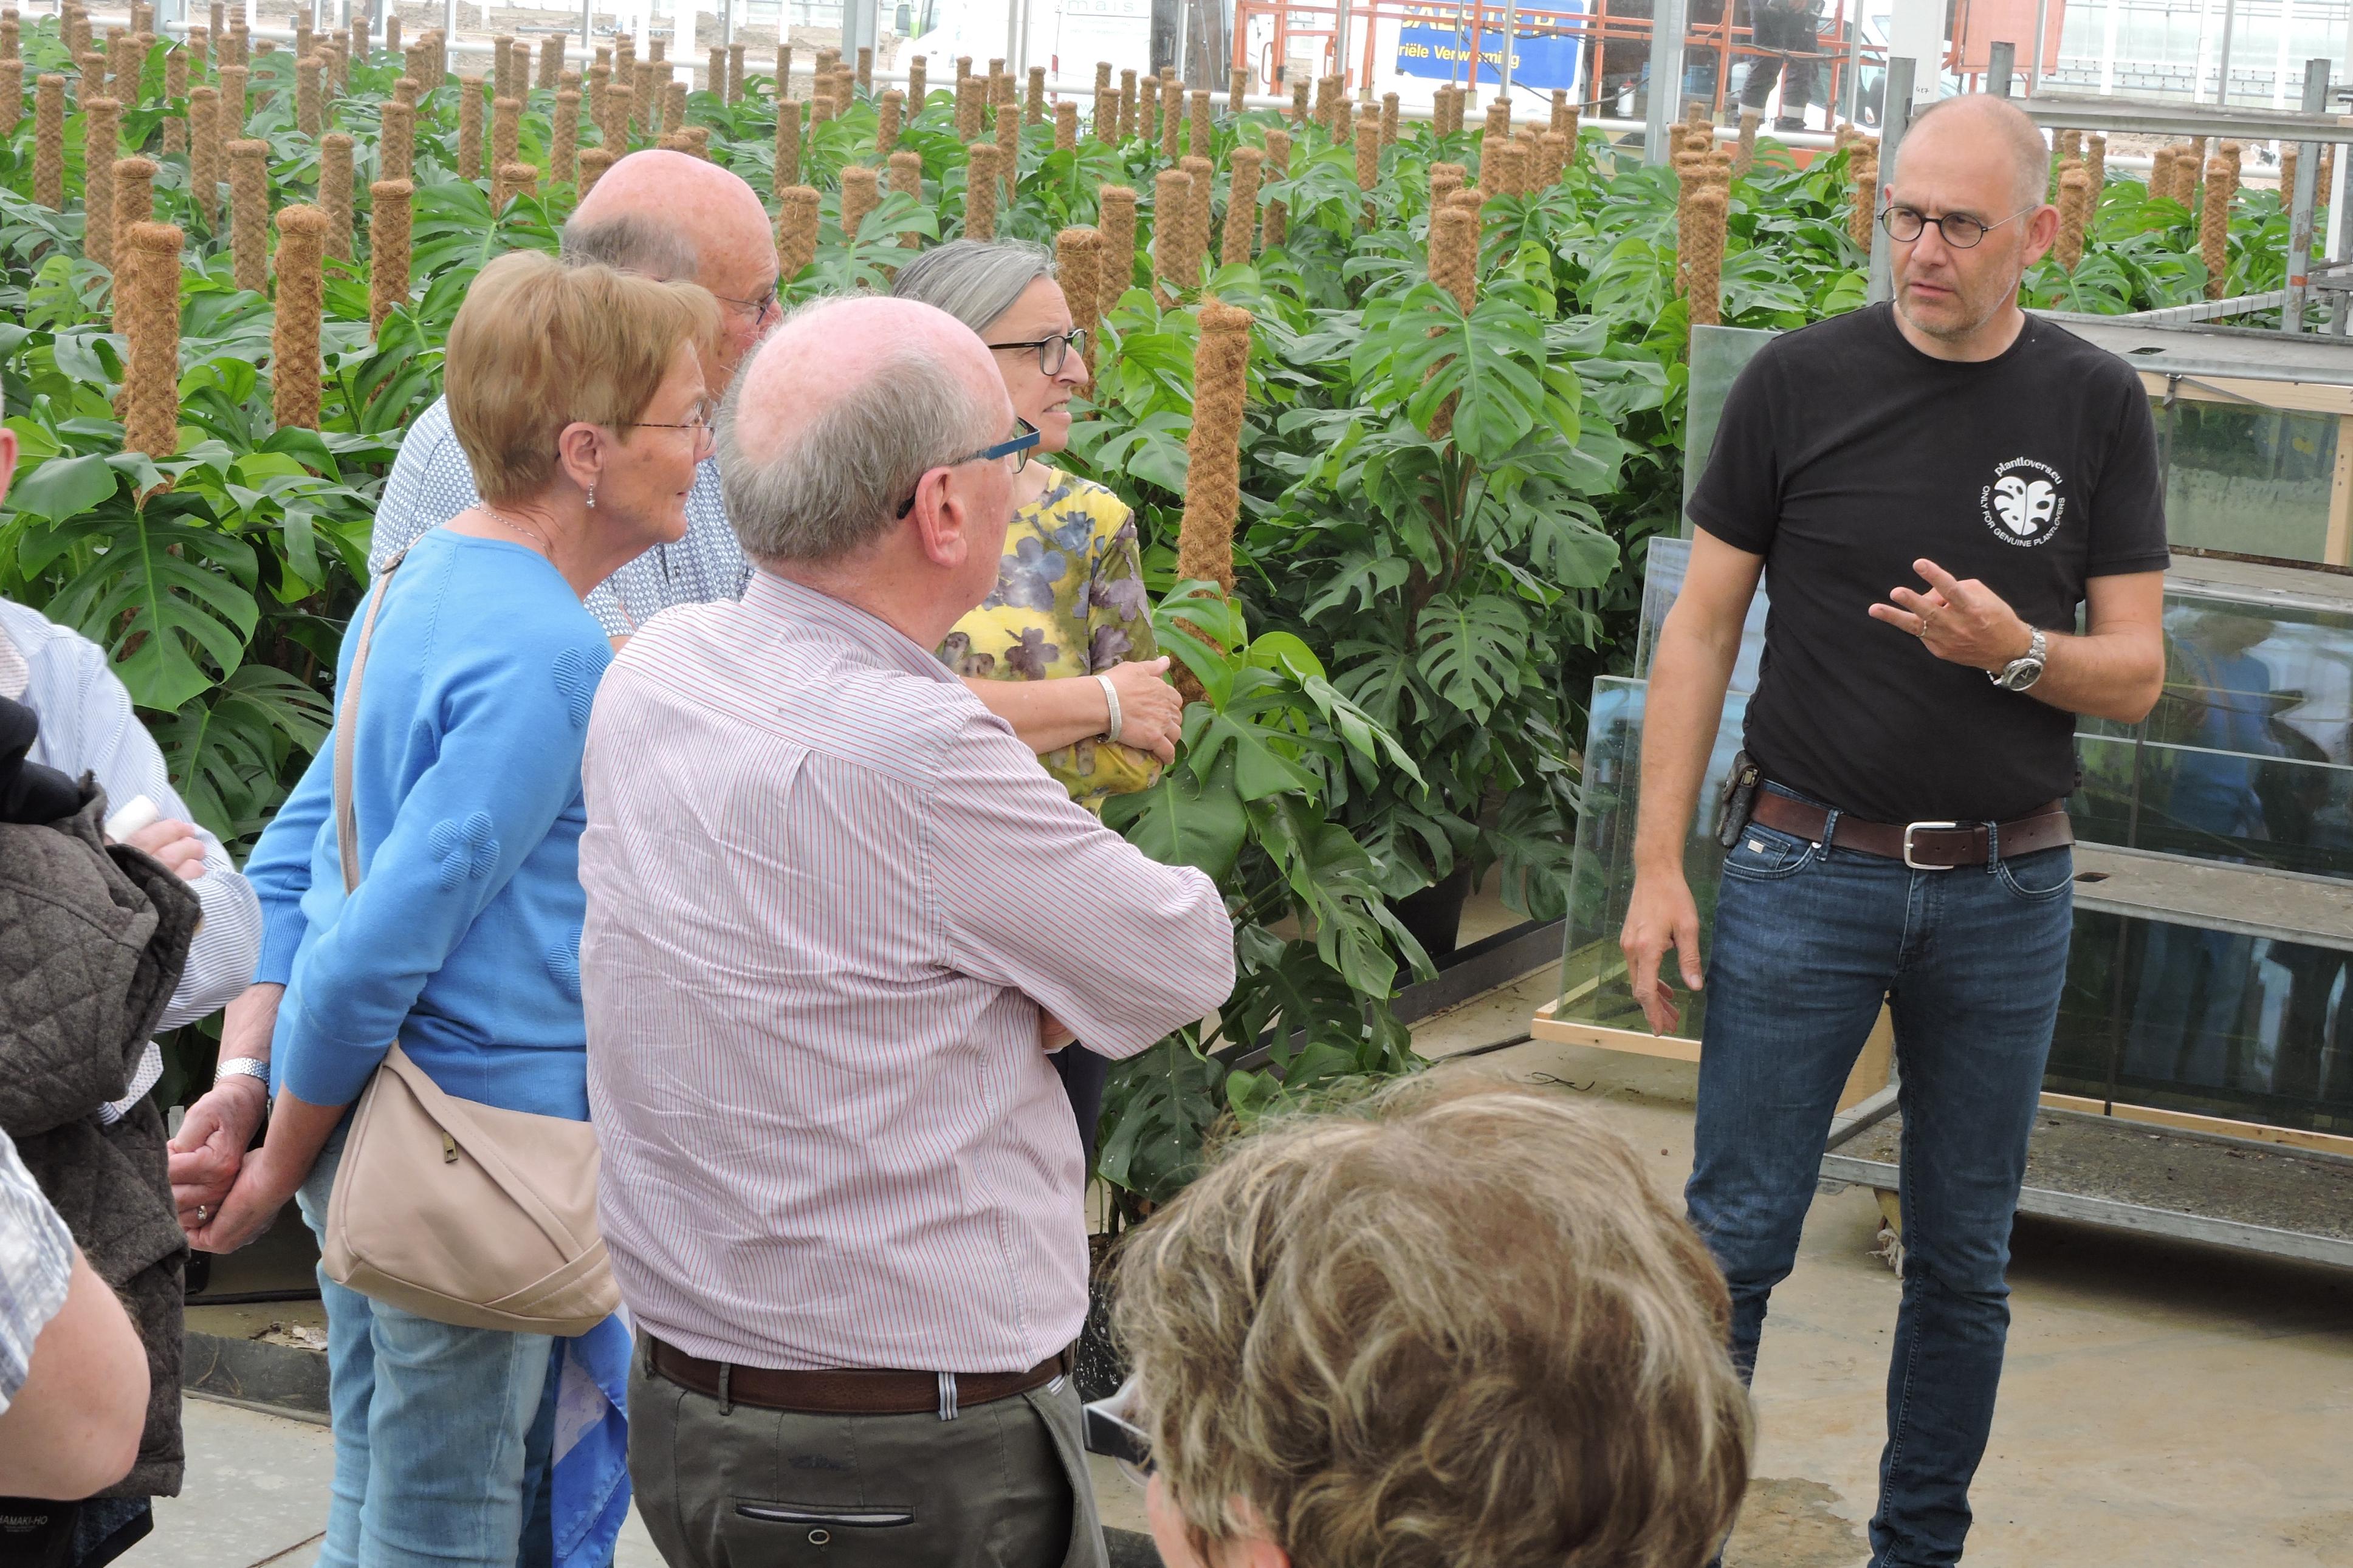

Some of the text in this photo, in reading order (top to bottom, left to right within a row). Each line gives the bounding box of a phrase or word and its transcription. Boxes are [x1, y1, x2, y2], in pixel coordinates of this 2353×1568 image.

[1434, 45, 1520, 69] Verwrmig
[1994, 457, 2063, 485] plantlovers.eu
[1980, 485, 1990, 509] ONLY
[1982, 510, 1996, 529] FOR
[1993, 528, 2032, 547] GENUINE
